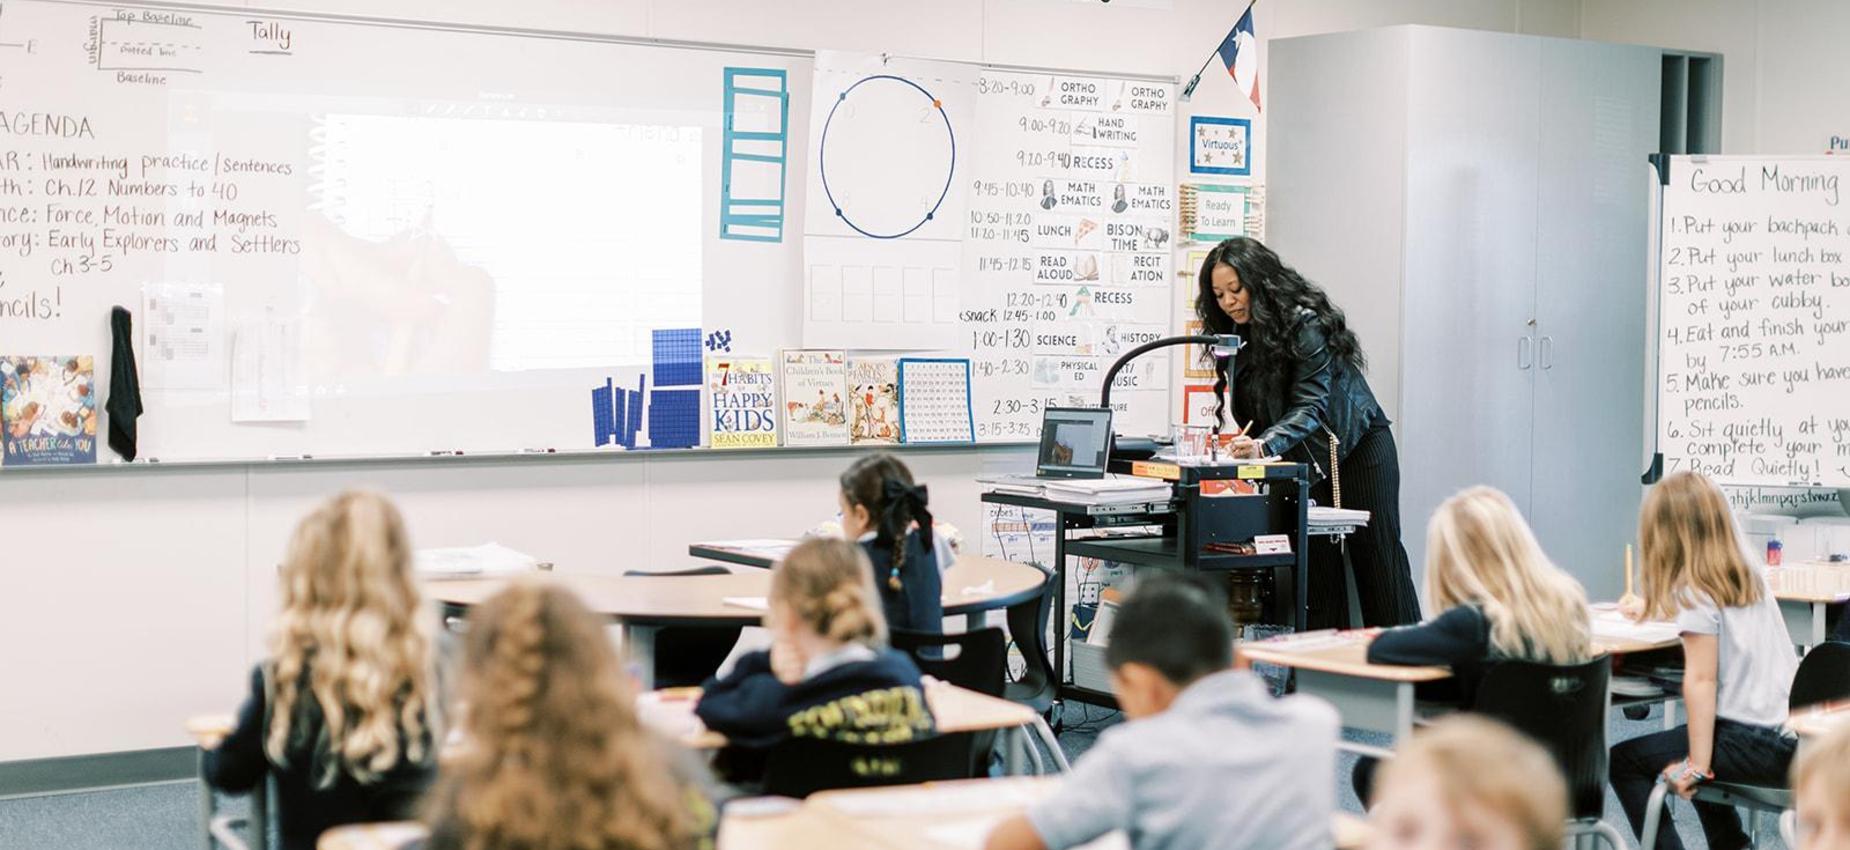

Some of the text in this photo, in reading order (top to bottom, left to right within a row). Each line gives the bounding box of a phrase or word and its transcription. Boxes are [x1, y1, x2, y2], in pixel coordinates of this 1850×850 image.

[112, 9, 135, 26] Top
[246, 21, 292, 50] Tally
[117, 71, 167, 85] Baseline
[1060, 82, 1096, 94] ORTHO
[1131, 87, 1165, 99] ORTHO
[1060, 95, 1100, 106] GRAPHY
[1130, 99, 1168, 112] GRAPHY
[1098, 118, 1125, 128] HAND
[1098, 130, 1137, 142] WRITING
[1201, 139, 1239, 150] Virtuous
[43, 152, 128, 180] Handwriting
[1073, 156, 1113, 170] RECESS
[108, 179, 178, 197] Numbers
[188, 180, 205, 198] to
[211, 182, 238, 201] 40
[1068, 182, 1096, 194] MATH
[1138, 186, 1165, 197] MATH
[1691, 164, 1839, 206] Good Morning
[1060, 195, 1102, 207] EMATICS
[1131, 199, 1171, 210] EMATICS
[1205, 200, 1232, 212] Ready
[104, 205, 165, 226] Motion
[174, 210, 204, 229] and
[213, 209, 278, 234] Magnets
[1201, 216, 1236, 227] To Learn
[1037, 224, 1072, 237] LUNCH
[1106, 223, 1143, 237] BISON
[1722, 221, 1758, 244] your
[1768, 215, 1838, 241] backpack
[48, 229, 95, 258] Early
[103, 228, 178, 257] Explorers
[189, 233, 217, 252] and
[231, 234, 301, 255] Settlers
[1111, 238, 1138, 251] TIME
[1040, 256, 1067, 267] READ
[1133, 256, 1161, 267] RECIT
[1726, 251, 1764, 273] your
[1773, 246, 1814, 264] lunch
[1820, 247, 1842, 263] box
[1037, 269, 1073, 280] ALOUD
[1131, 270, 1163, 281] ATION
[1725, 275, 1760, 297] your
[1769, 268, 1822, 287] water
[1094, 291, 1133, 304] RECESS
[1688, 290, 1830, 320] of your cubby.
[1721, 320, 1750, 339] and
[1759, 318, 1804, 337] finish
[1036, 335, 1077, 346] SCIENCE
[1121, 333, 1162, 343] HISTORY
[1686, 353, 1706, 374] by
[1719, 343, 1763, 363] 7:55
[1060, 361, 1098, 371] PHYSICAL
[718, 363, 730, 386] 7
[728, 373, 772, 385] HABITS
[1074, 372, 1084, 381] ED
[1738, 370, 1776, 387] sure
[1783, 369, 1810, 394] you
[1815, 361, 1850, 380] have
[713, 392, 772, 408] HAPPY
[714, 409, 774, 432] KIDS
[1722, 417, 1783, 447] quietly
[1799, 415, 1819, 434] at
[714, 433, 775, 443] SEAN COVEY
[17, 437, 57, 455] TEACHER
[74, 440, 92, 455] YOU
[1686, 437, 1766, 462] complete
[1785, 441, 1822, 459] your
